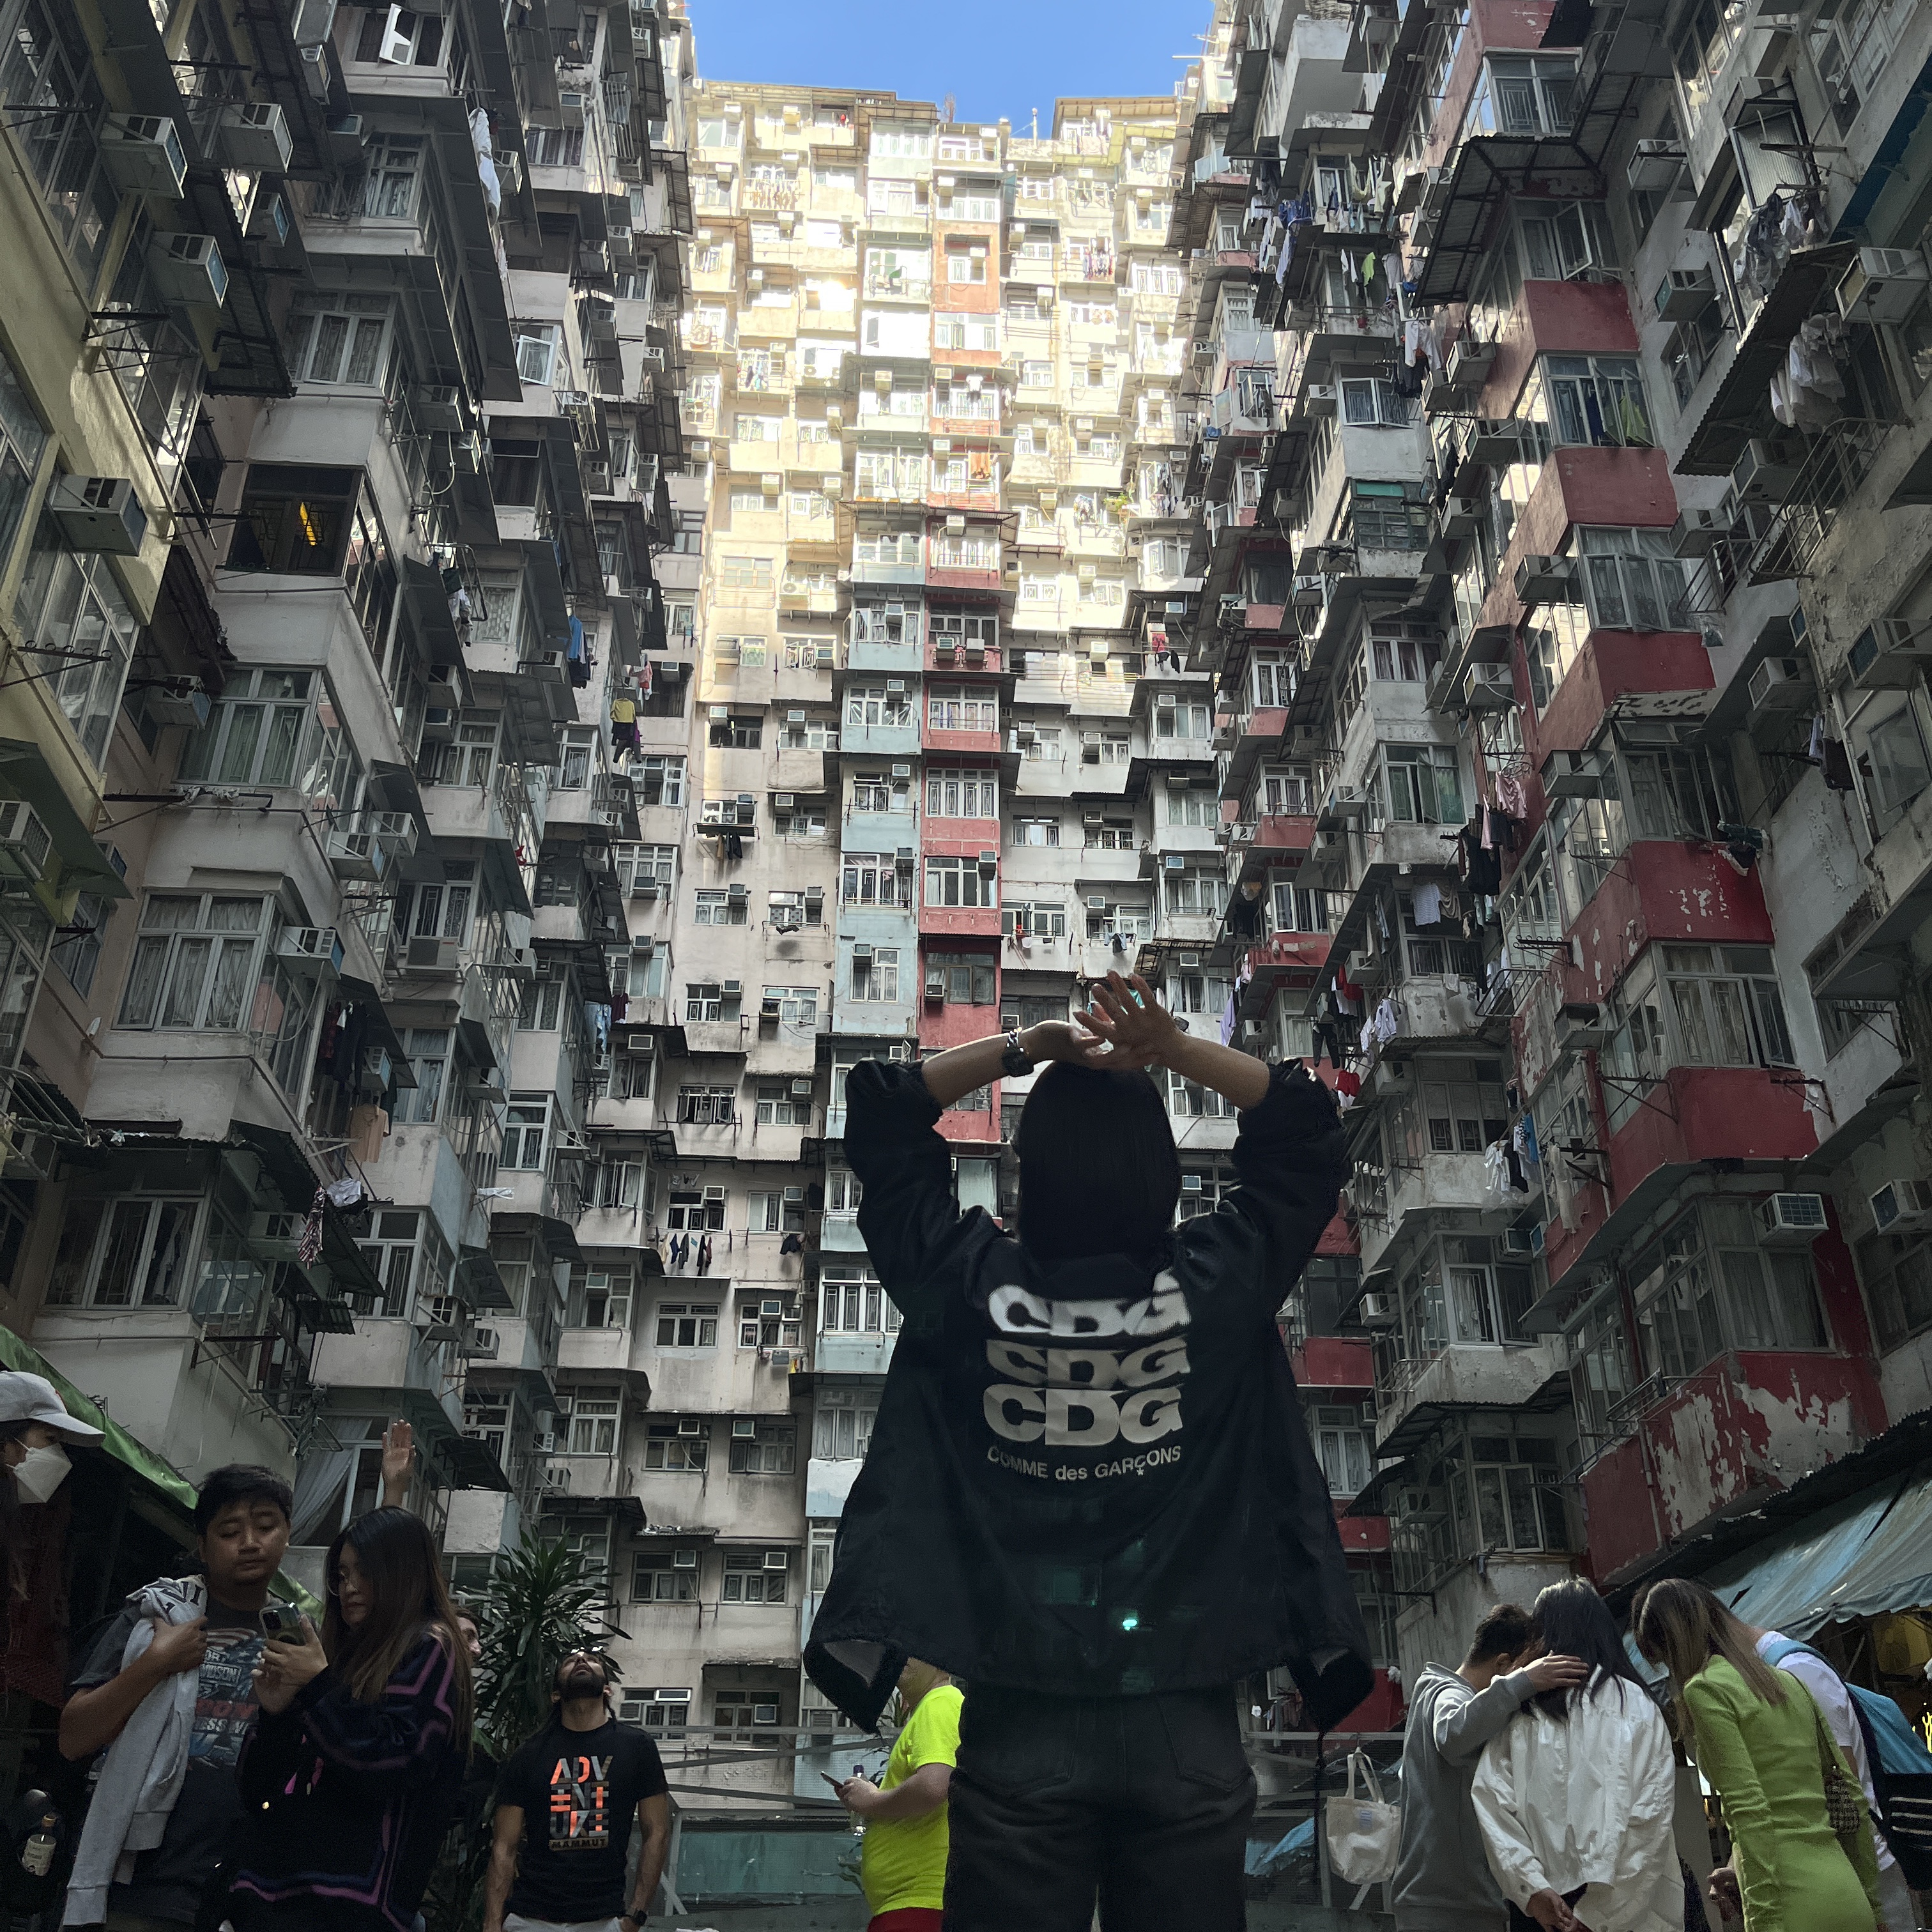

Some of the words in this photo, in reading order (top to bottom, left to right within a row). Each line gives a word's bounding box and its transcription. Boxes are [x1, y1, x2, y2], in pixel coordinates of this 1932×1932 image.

[988, 1268, 1191, 1337] CDG
[986, 1334, 1191, 1388] CDG
[983, 1383, 1183, 1446] CDG
[986, 1446, 1048, 1479] COMME
[1055, 1465, 1087, 1480] des
[1094, 1445, 1181, 1476] GARÇONS
[550, 1756, 613, 1784] ADV
[551, 1838, 606, 1850] MAMMUT
